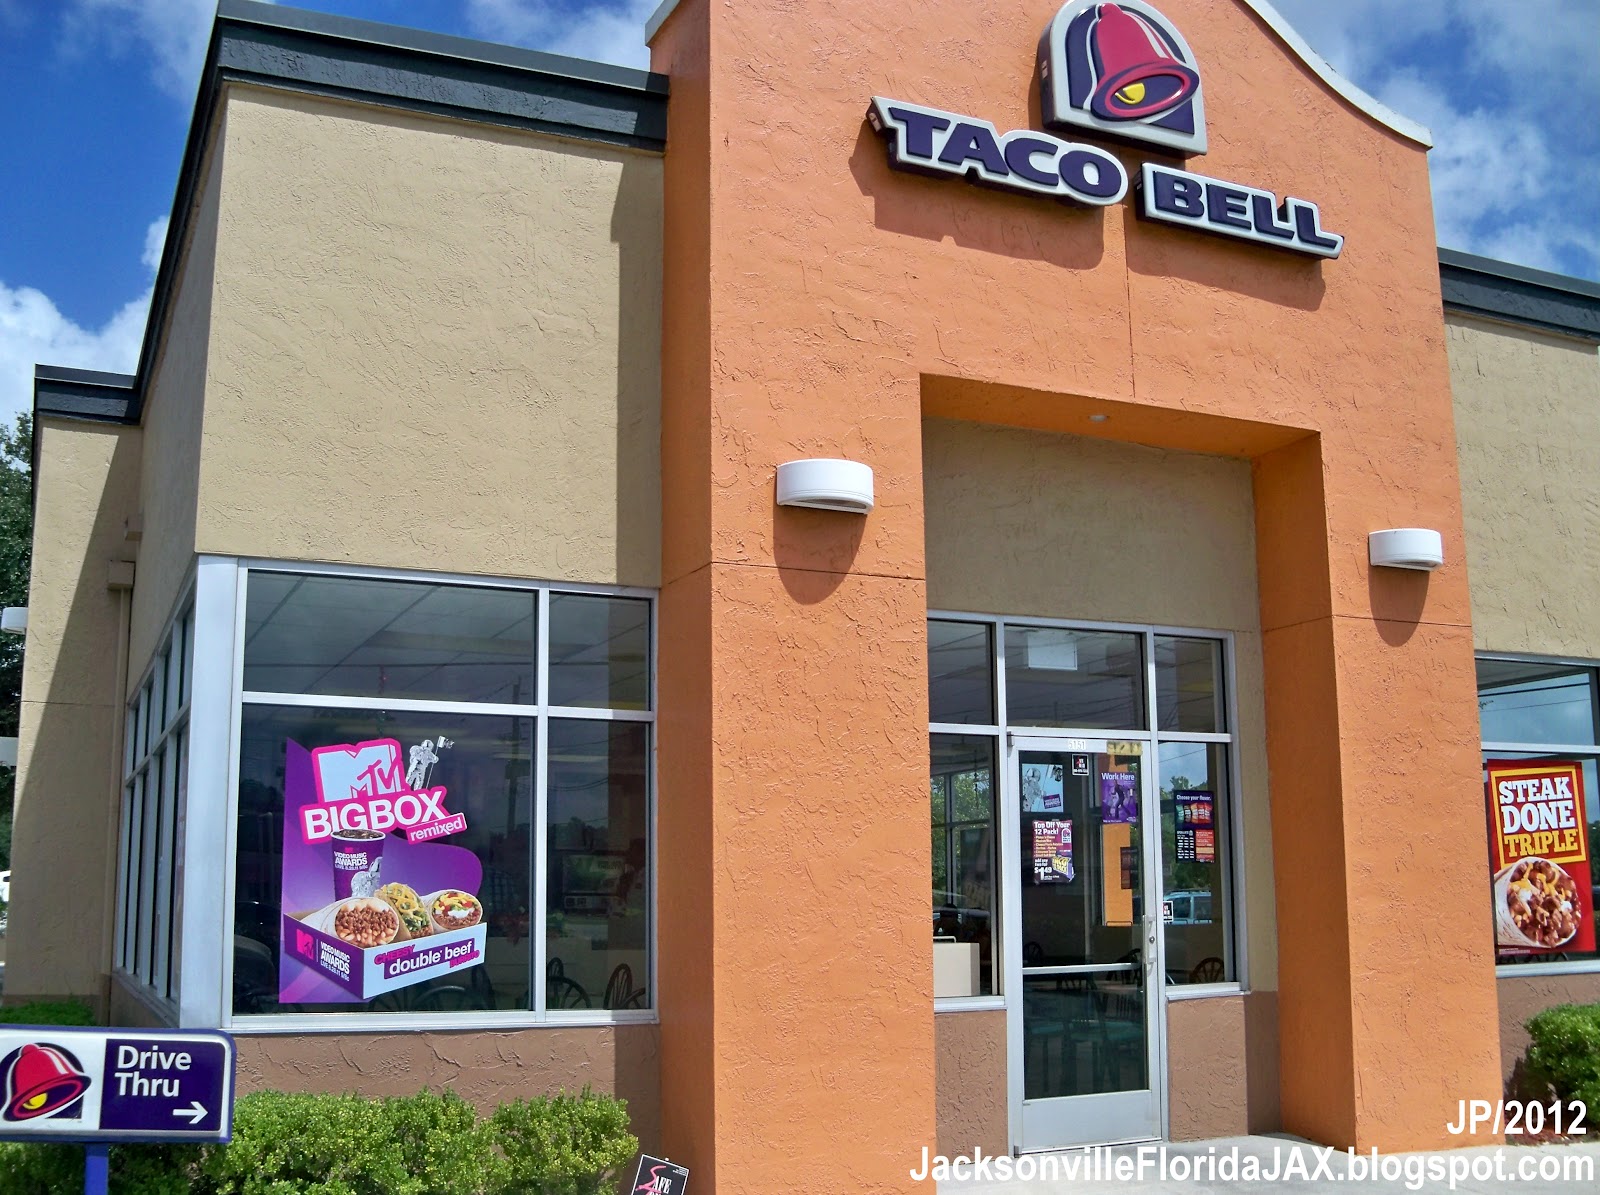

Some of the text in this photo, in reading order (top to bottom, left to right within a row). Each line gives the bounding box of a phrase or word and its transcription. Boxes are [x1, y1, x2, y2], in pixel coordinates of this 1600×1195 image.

[888, 106, 1122, 198] TACO
[1154, 170, 1338, 250] BELL
[1068, 740, 1086, 750] 5151
[318, 744, 402, 803] MTV
[1101, 772, 1135, 781] Work Here
[1498, 777, 1572, 804] STEAK
[1033, 821, 1070, 829] Top Off Your
[1501, 800, 1575, 834] DONE
[410, 818, 463, 842] remixed
[1504, 831, 1578, 857] TRIPLE
[335, 857, 368, 866] AWARDS
[320, 950, 349, 974] AWARDS
[321, 941, 350, 962] VIDEO MUSIC
[374, 944, 415, 965] CHEESY
[389, 941, 472, 975] double beef
[117, 1045, 191, 1070] Drive
[115, 1072, 180, 1097] Thru
